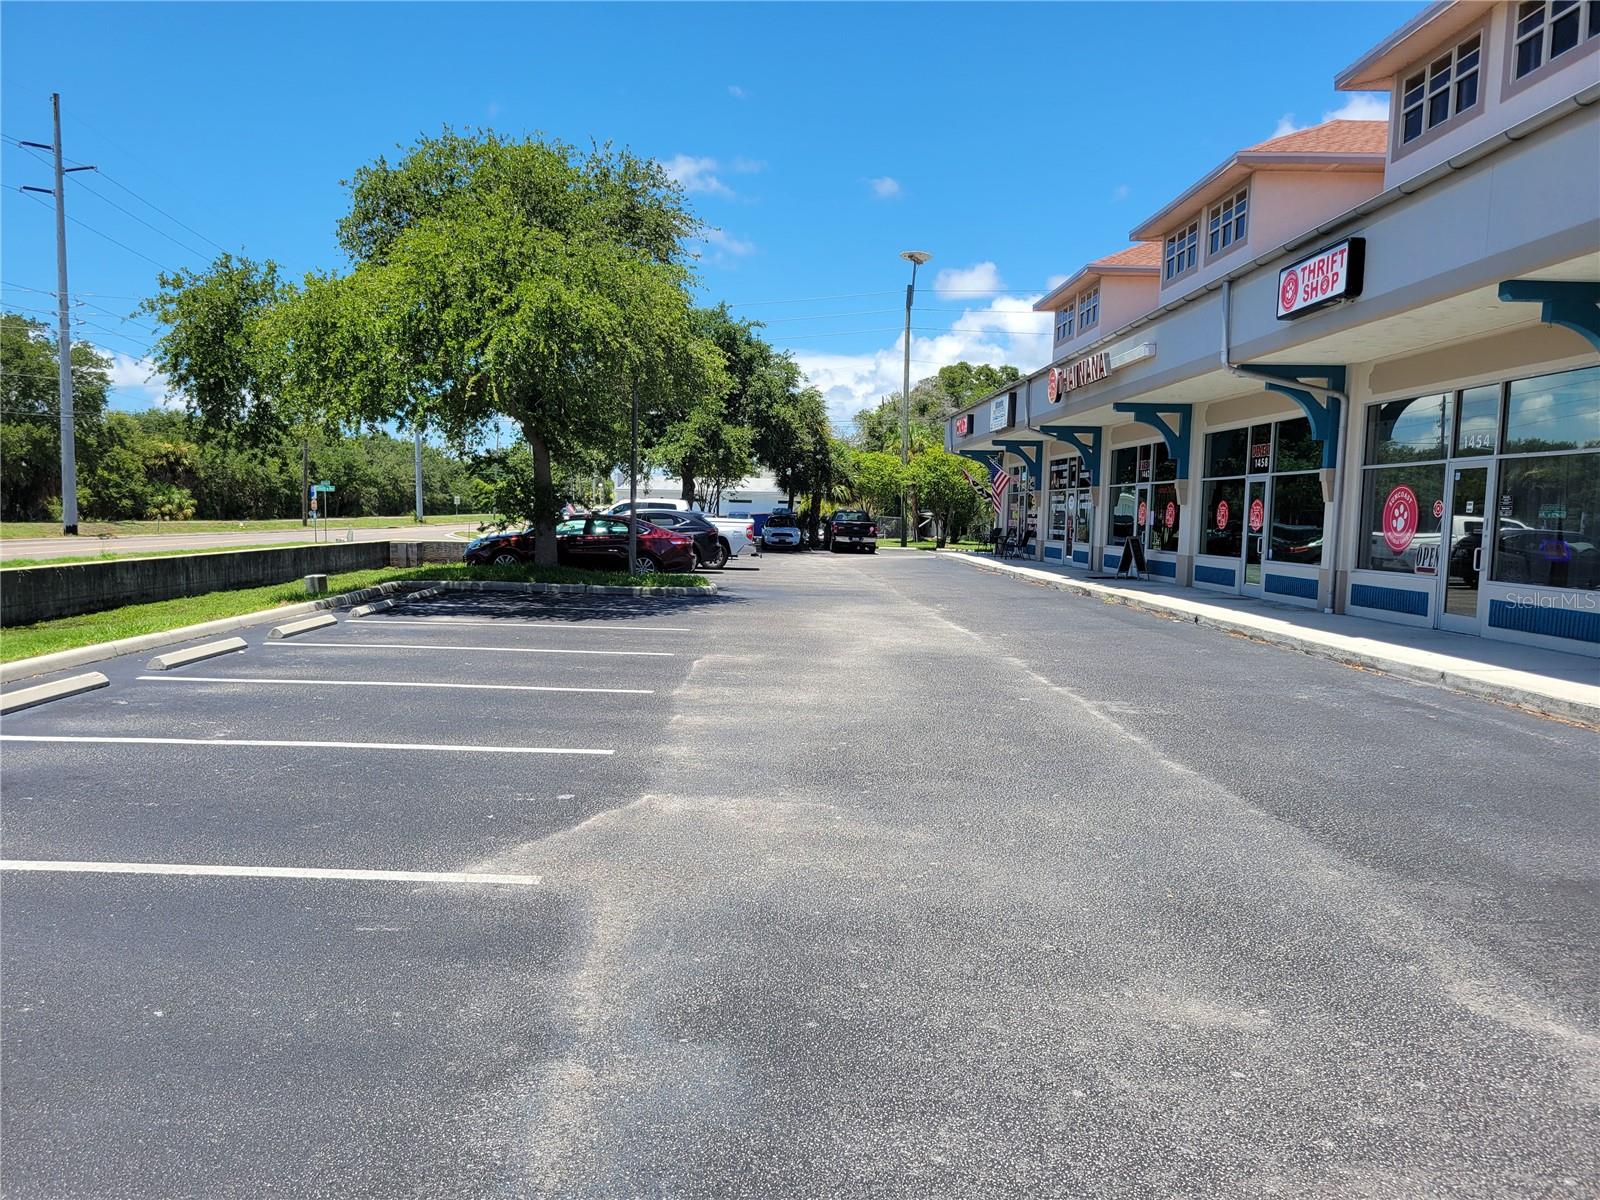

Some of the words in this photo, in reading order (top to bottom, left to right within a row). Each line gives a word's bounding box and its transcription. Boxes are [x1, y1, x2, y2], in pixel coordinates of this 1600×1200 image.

[1301, 247, 1346, 286] THRIFT
[1303, 272, 1339, 303] SHOP
[1464, 434, 1490, 448] 1454
[1255, 457, 1268, 468] 1458
